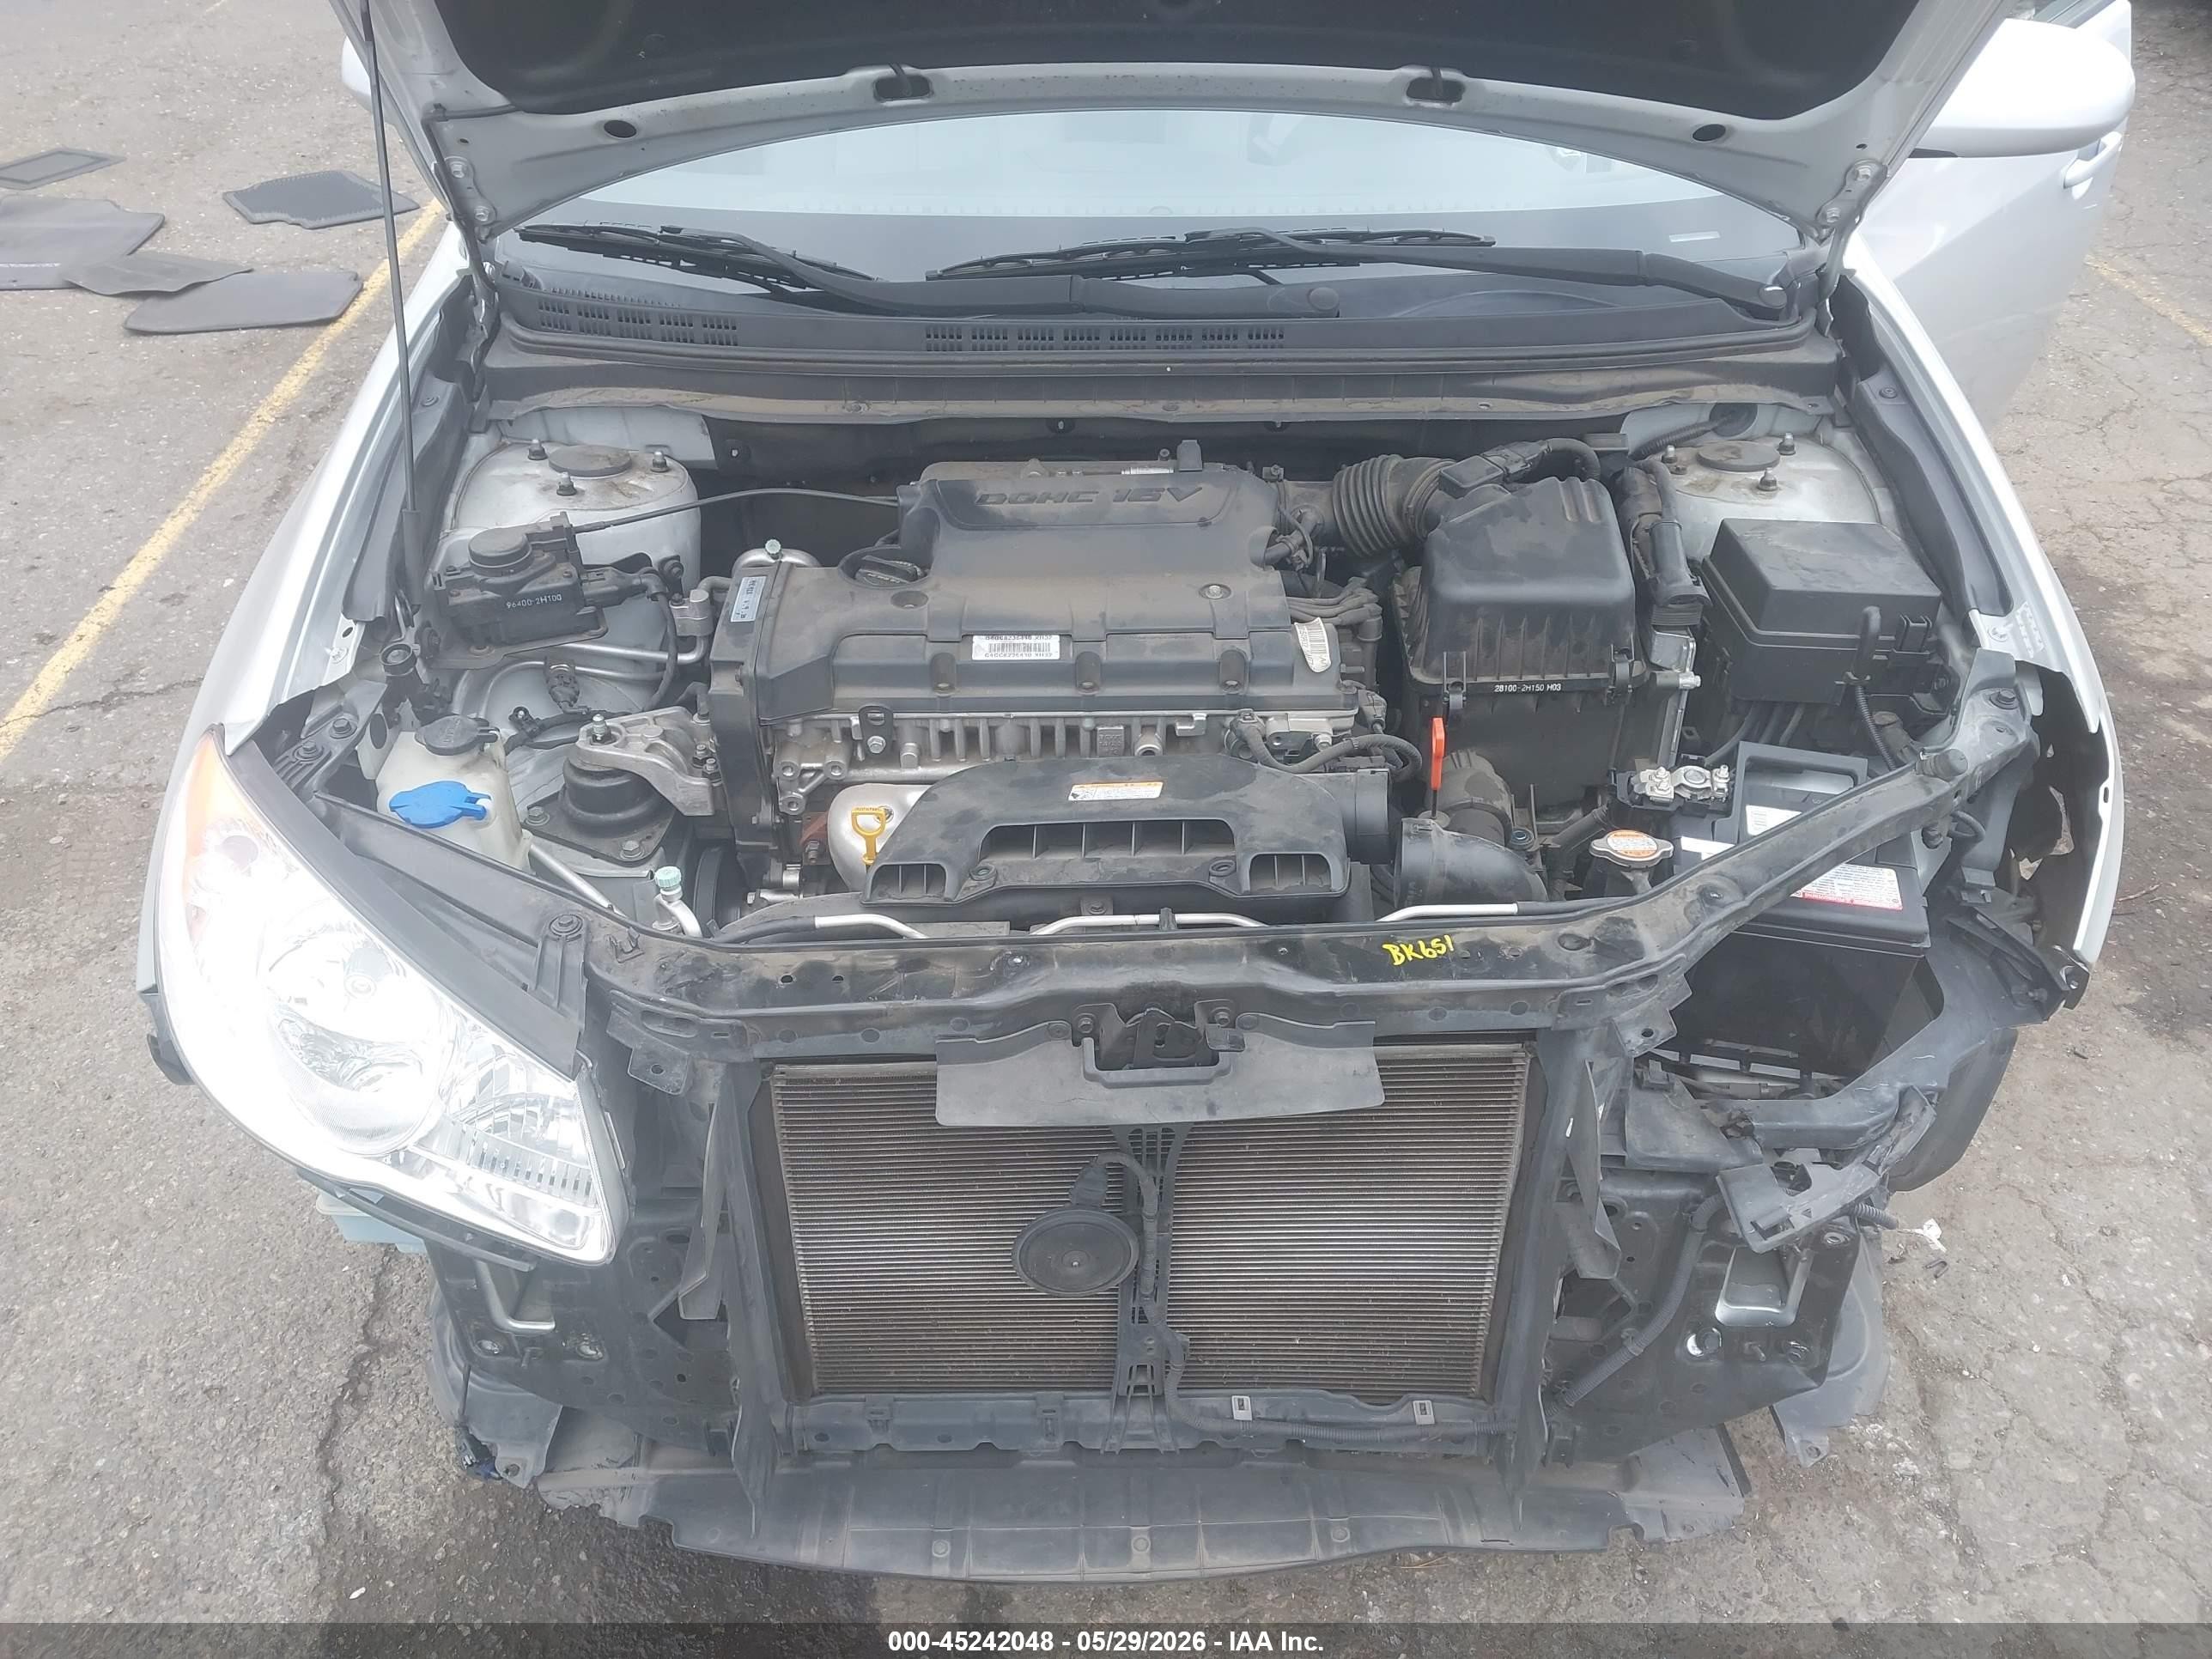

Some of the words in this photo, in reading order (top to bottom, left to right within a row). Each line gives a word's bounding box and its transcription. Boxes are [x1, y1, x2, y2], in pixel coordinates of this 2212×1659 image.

[975, 491, 1099, 506] DOHC
[1112, 486, 1203, 503] 16V
[506, 593, 562, 609] 96400-2H100
[1494, 684, 1545, 693] 28100-2H150
